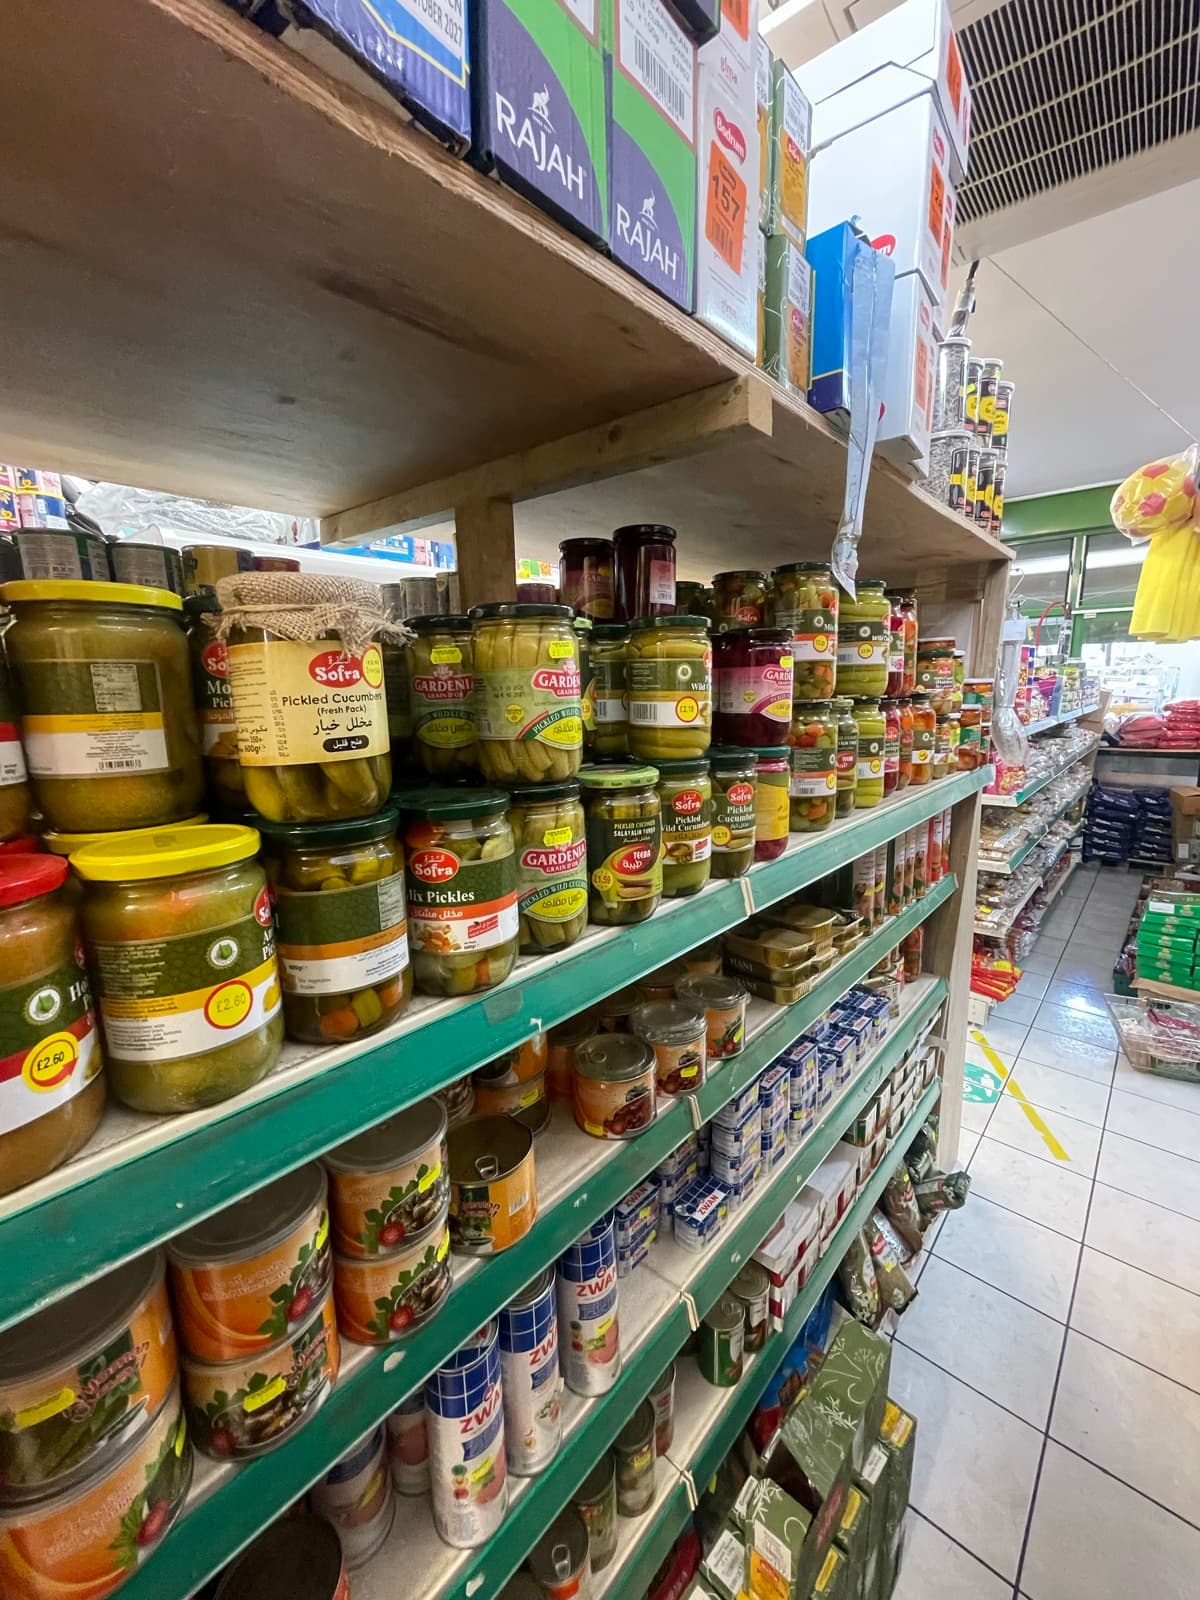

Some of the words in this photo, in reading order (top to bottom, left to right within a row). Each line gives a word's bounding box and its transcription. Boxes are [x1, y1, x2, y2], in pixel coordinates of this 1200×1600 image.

[715, 114, 745, 160] Bodrum
[495, 91, 584, 201] RAJAH
[711, 174, 741, 222] 157
[617, 202, 677, 281] RAJAH
[314, 664, 361, 682] Sofra
[282, 694, 329, 707] Pickled
[317, 706, 344, 717] (Fresh
[345, 704, 367, 715] Pack)
[730, 791, 753, 802] Sofra
[675, 800, 701, 811] Sofra
[726, 804, 754, 815] Pickled
[613, 822, 635, 830] PICKLED
[675, 814, 702, 825] Pickled
[414, 863, 454, 878] Sofra
[426, 890, 476, 904] Pickles
[215, 992, 247, 1014] £2.60
[36, 1050, 65, 1072] £2.60
[697, 1194, 719, 1215] ZWAN
